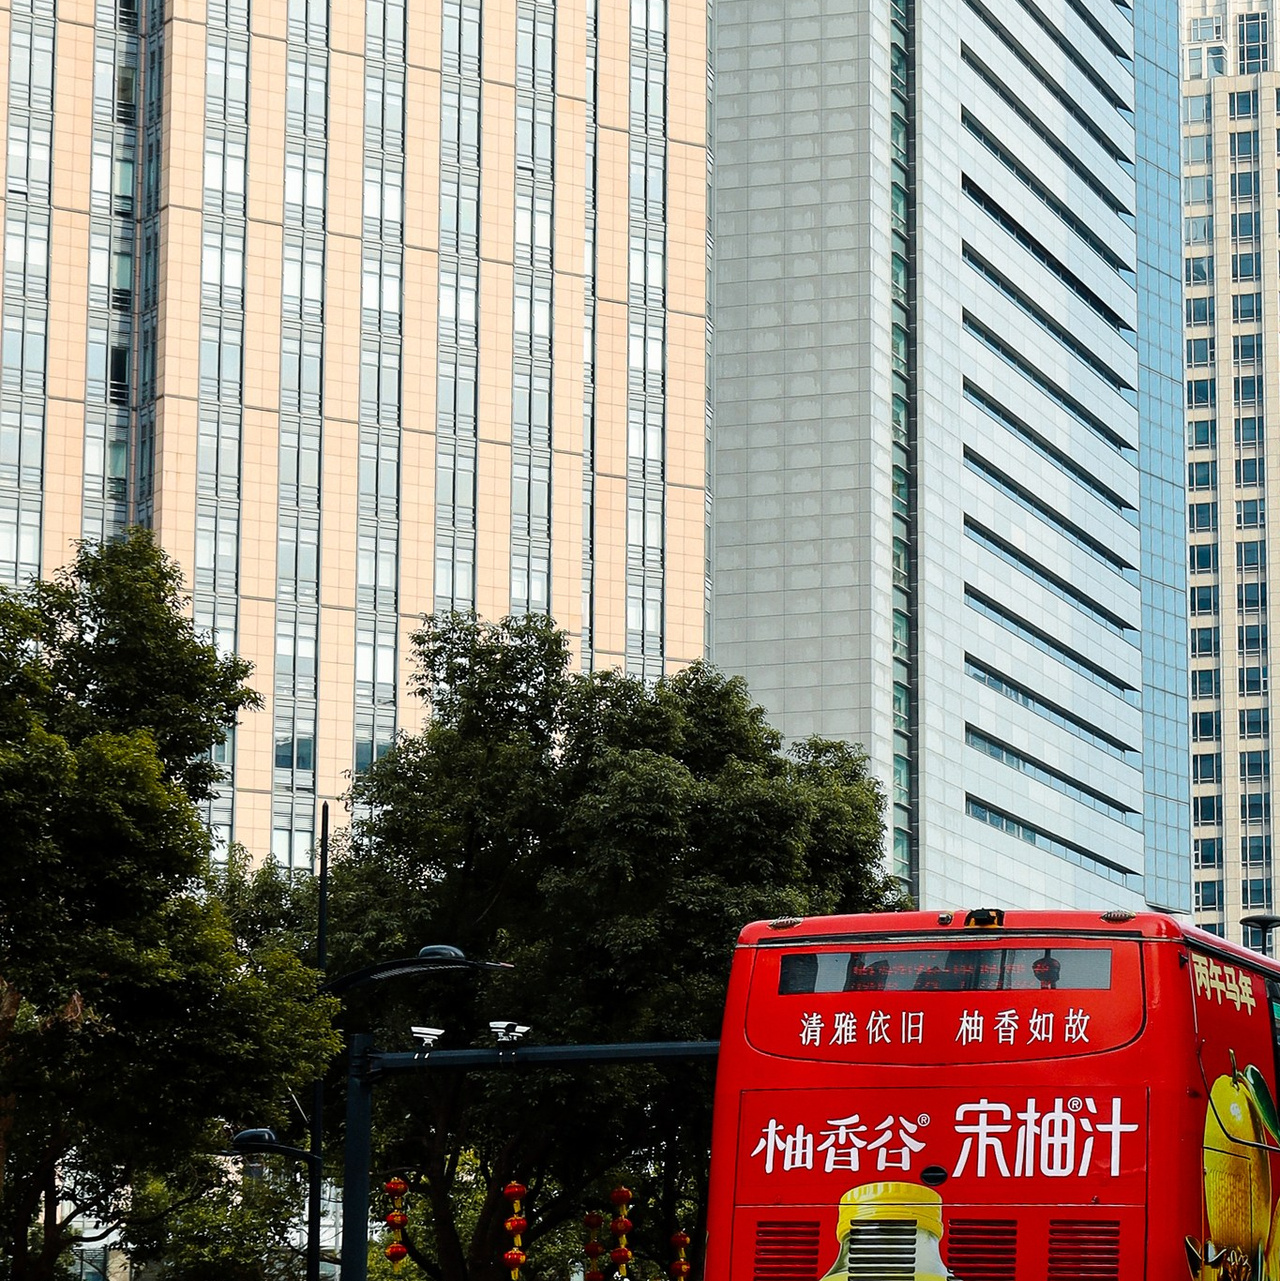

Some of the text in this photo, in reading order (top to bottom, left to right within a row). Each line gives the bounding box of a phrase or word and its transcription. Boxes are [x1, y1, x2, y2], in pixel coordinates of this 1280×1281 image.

[1191, 951, 1257, 1016] 丙午马年
[798, 1008, 1091, 1046] 清雅依旧 柚香如故
[751, 1114, 926, 1174] 柚香谷
